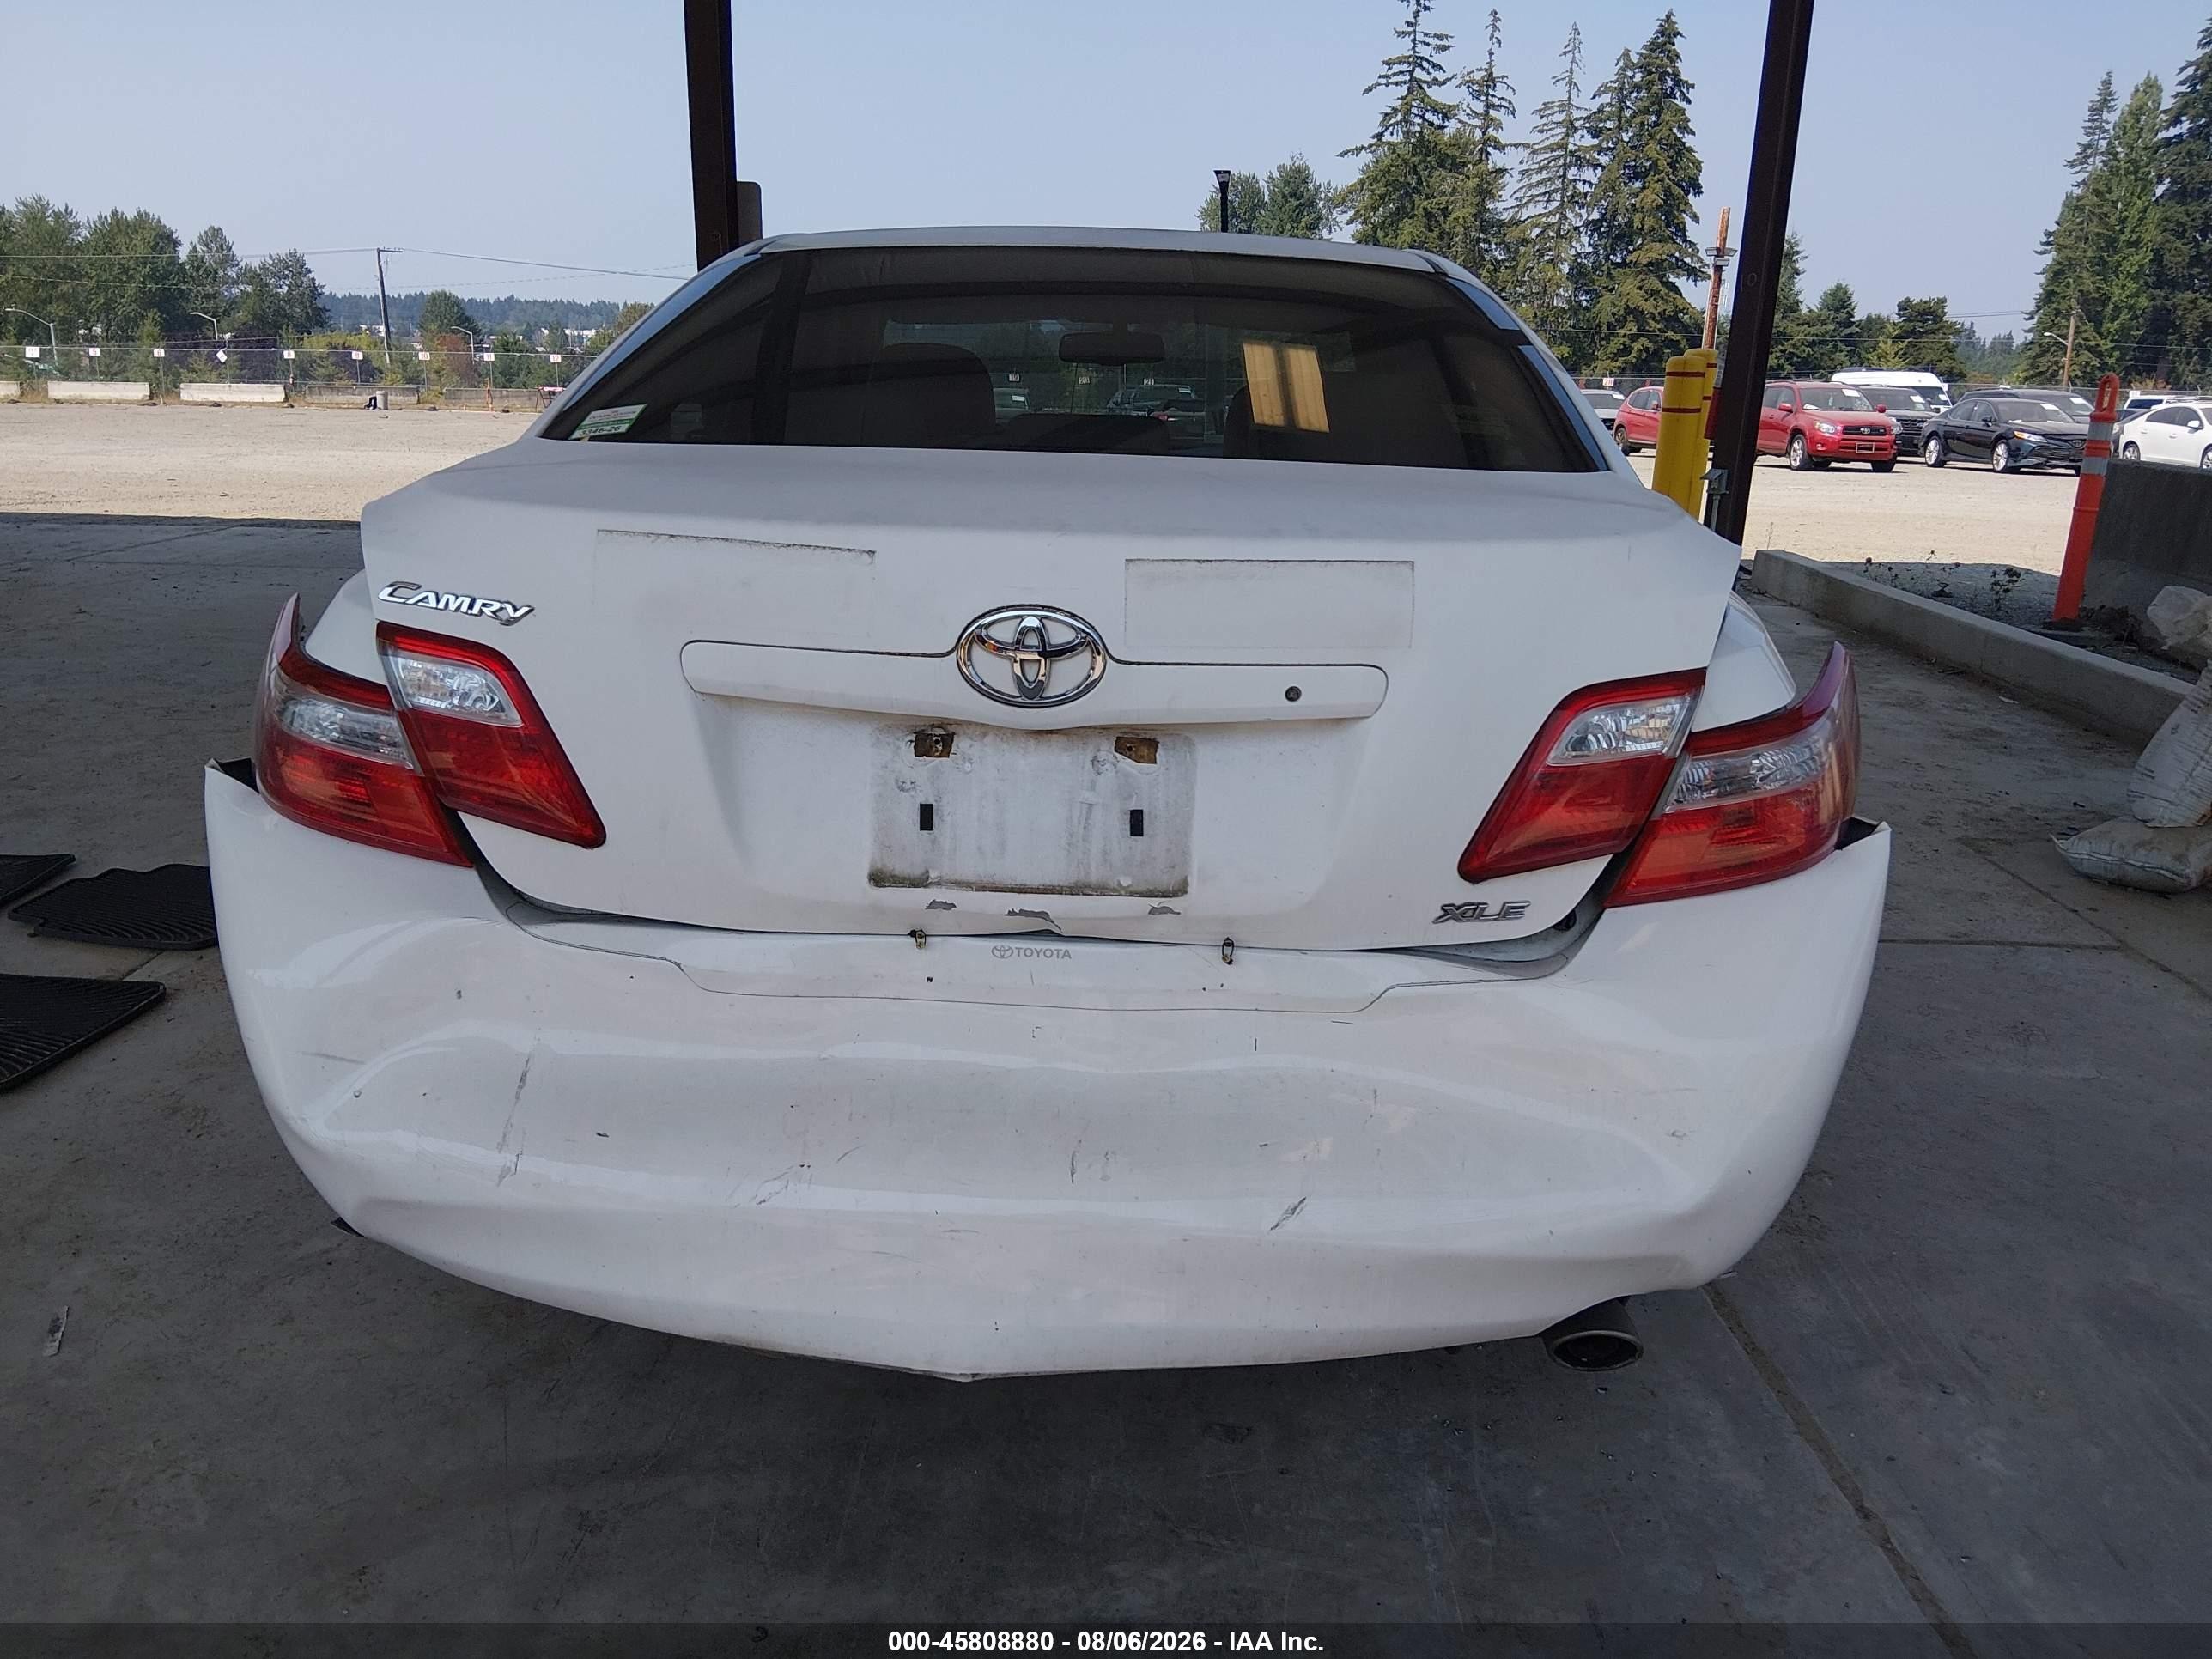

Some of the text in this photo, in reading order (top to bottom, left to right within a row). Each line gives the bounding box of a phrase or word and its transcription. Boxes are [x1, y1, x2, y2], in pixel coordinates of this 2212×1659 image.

[378, 580, 535, 627] CAMRY
[1431, 900, 1531, 925] XLE
[1014, 945, 1073, 960] TOYOTA
